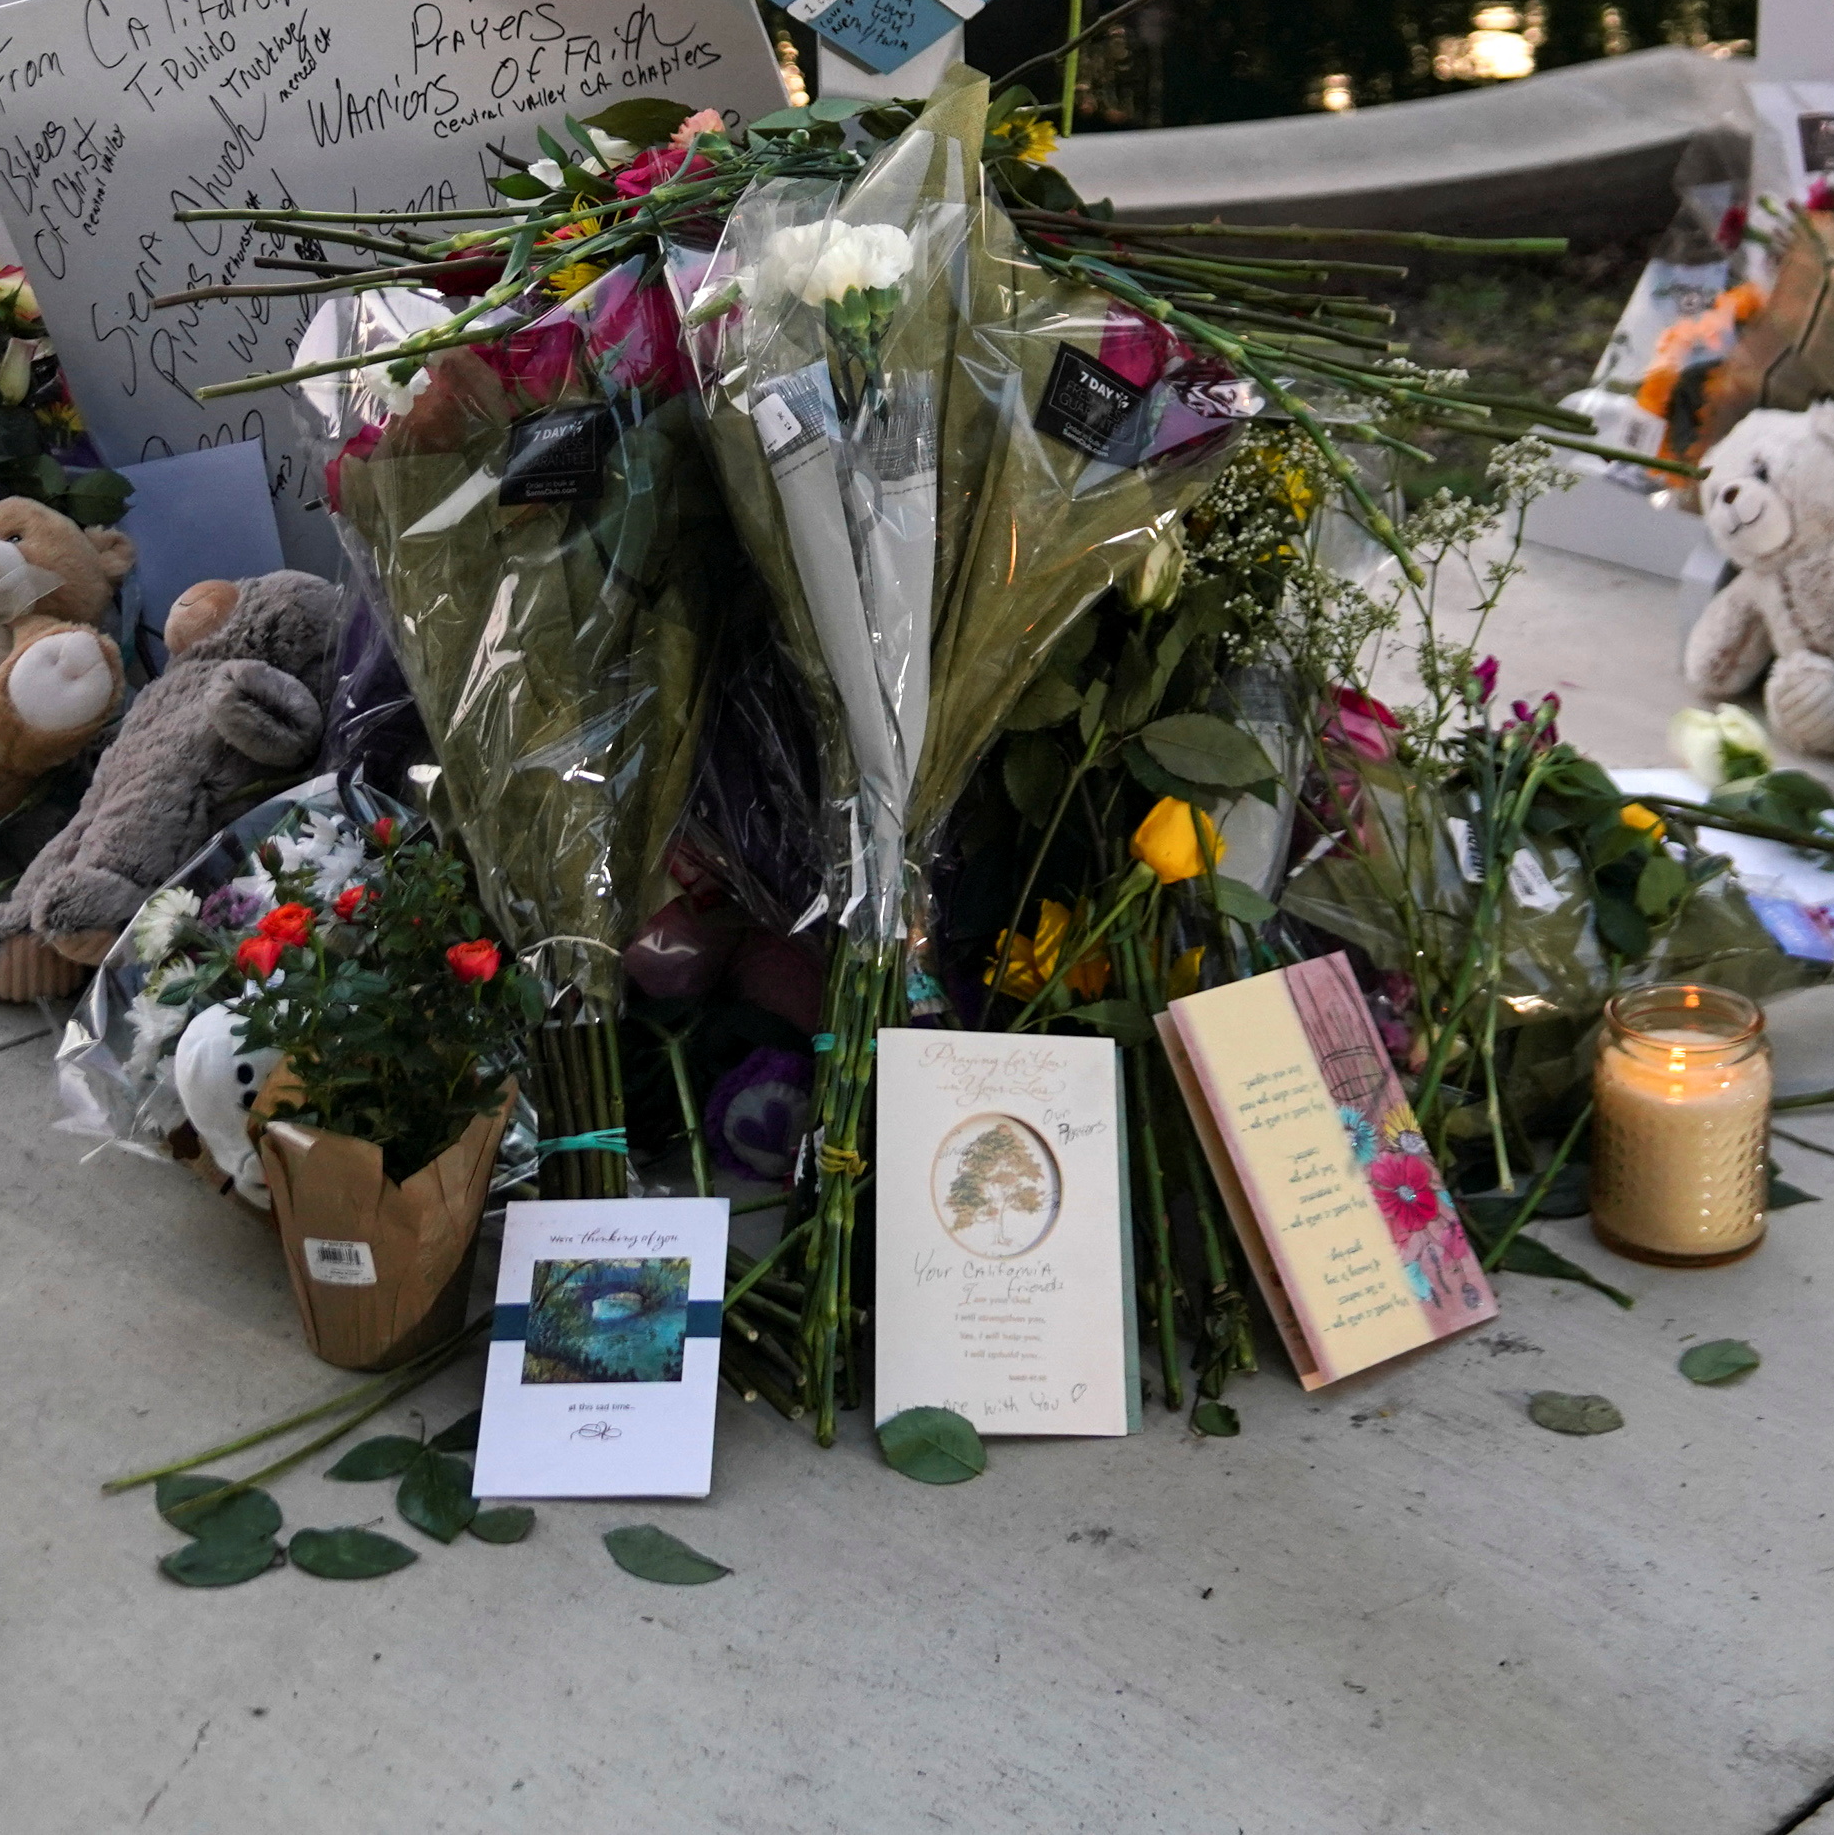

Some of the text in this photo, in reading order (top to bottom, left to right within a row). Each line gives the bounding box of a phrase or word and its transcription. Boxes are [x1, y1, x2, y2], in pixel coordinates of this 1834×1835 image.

[1079, 371, 1114, 399] 7 DAY
[533, 425, 568, 442] 7 DAY
[526, 488, 577, 497] SamsClub.com
[919, 1042, 999, 1076] Praying
[1003, 1050, 1027, 1076] for
[578, 1228, 638, 1249] thinking
[641, 1230, 656, 1247] of
[652, 1235, 678, 1252] you
[914, 1248, 953, 1287] Your
